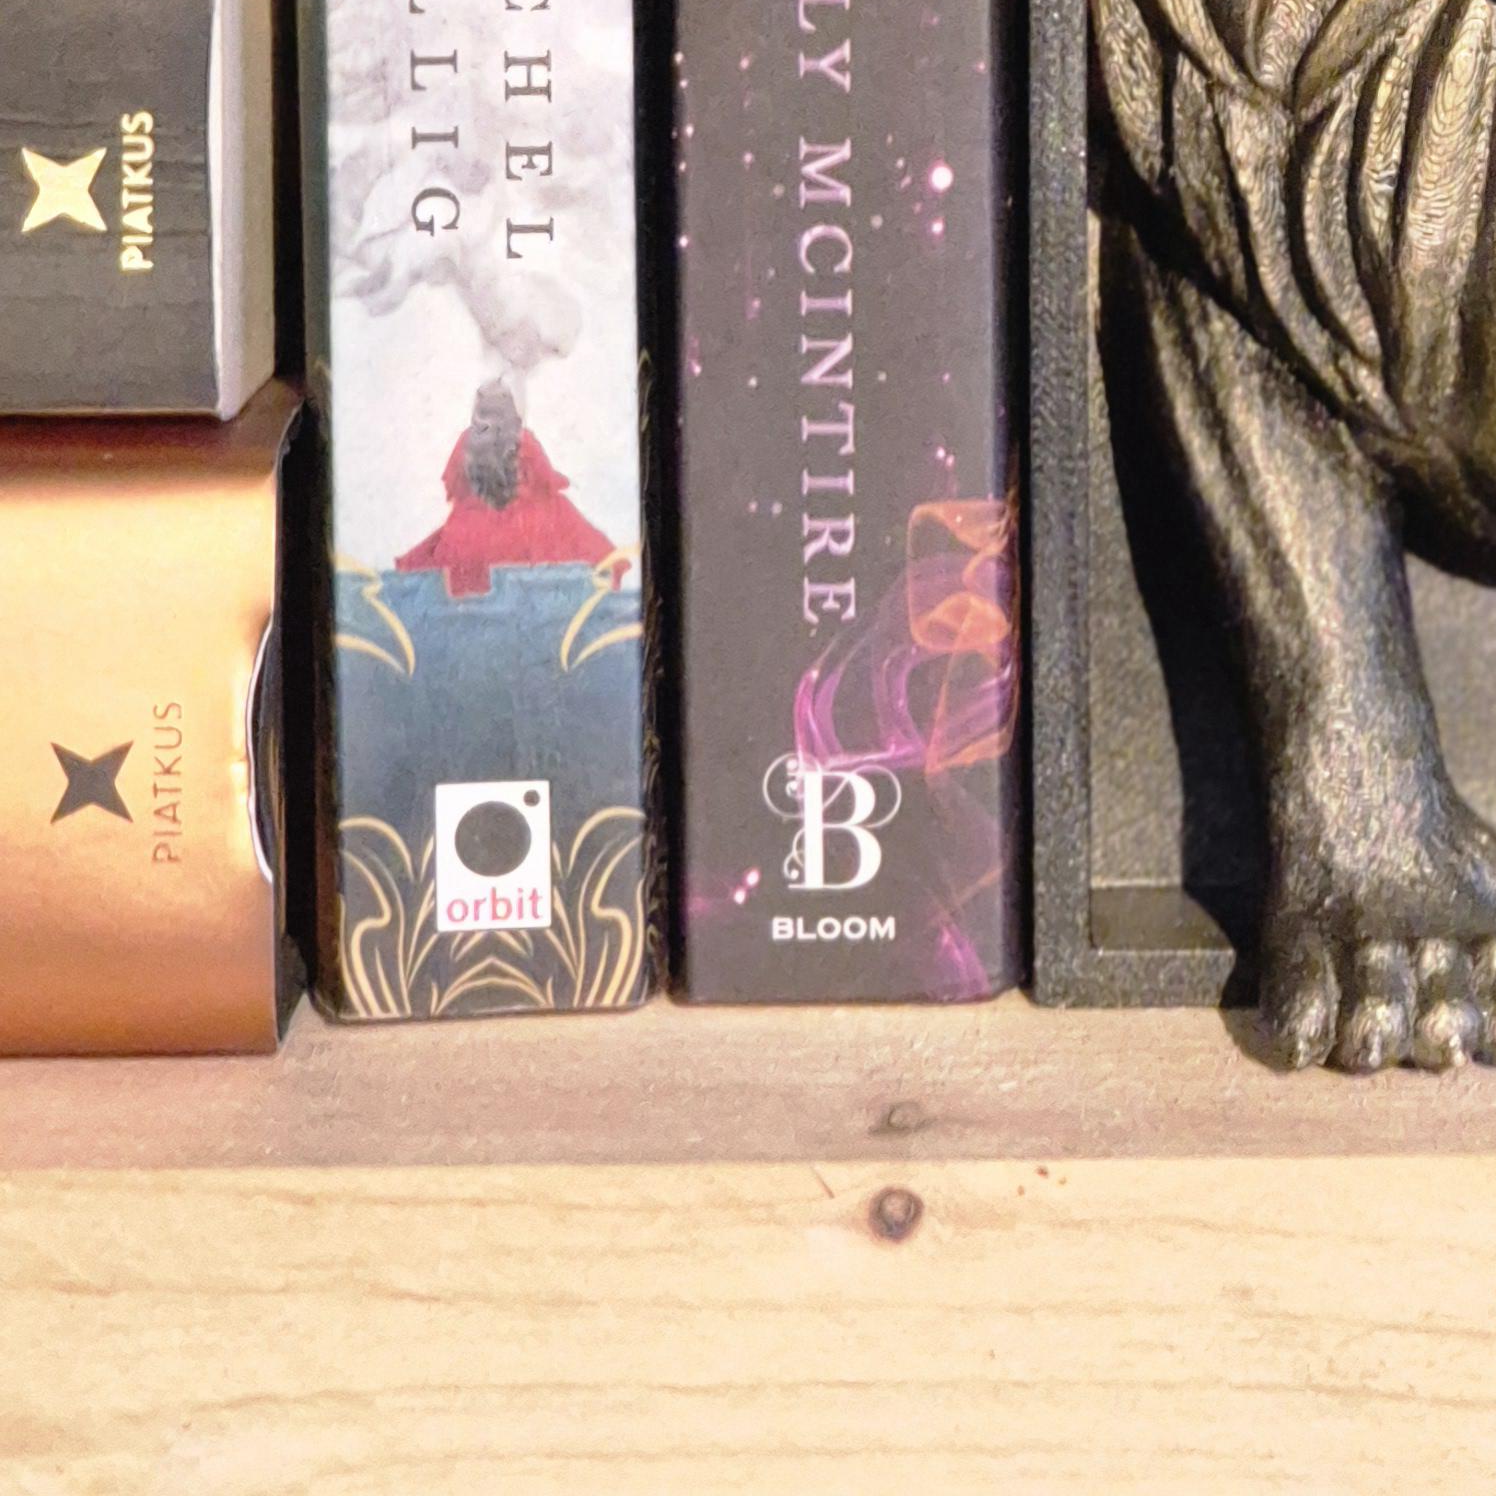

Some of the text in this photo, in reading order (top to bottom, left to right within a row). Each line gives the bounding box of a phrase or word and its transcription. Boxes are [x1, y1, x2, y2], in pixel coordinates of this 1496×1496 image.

[119, 110, 154, 272] PIATKUS
[799, 137, 857, 625] MCINTIRE
[152, 701, 183, 865] PIATKUS
[446, 886, 543, 923] orbit
[771, 916, 896, 941] BLOOM
